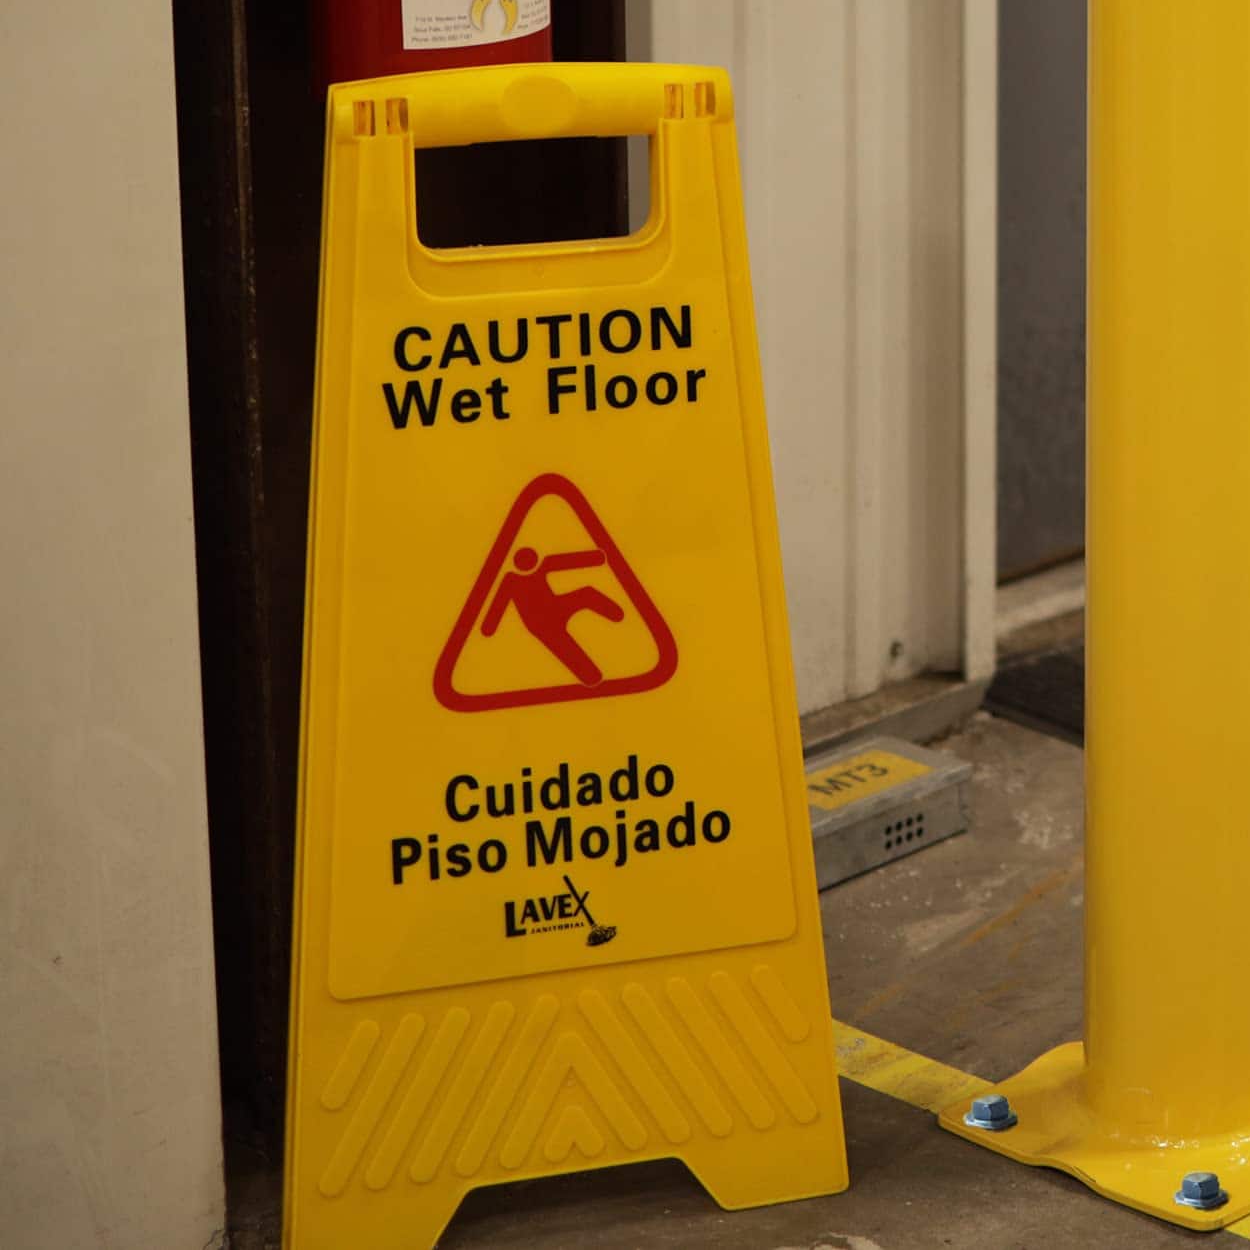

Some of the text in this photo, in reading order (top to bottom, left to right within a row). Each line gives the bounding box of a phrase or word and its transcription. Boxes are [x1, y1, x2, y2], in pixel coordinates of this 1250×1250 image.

[395, 306, 691, 371] CAUTION
[383, 365, 706, 430] Wet Floor
[446, 755, 674, 823] Cuidado
[808, 762, 889, 796] MT3
[392, 801, 731, 885] Piso Mojado
[504, 877, 593, 938] LAVEX
